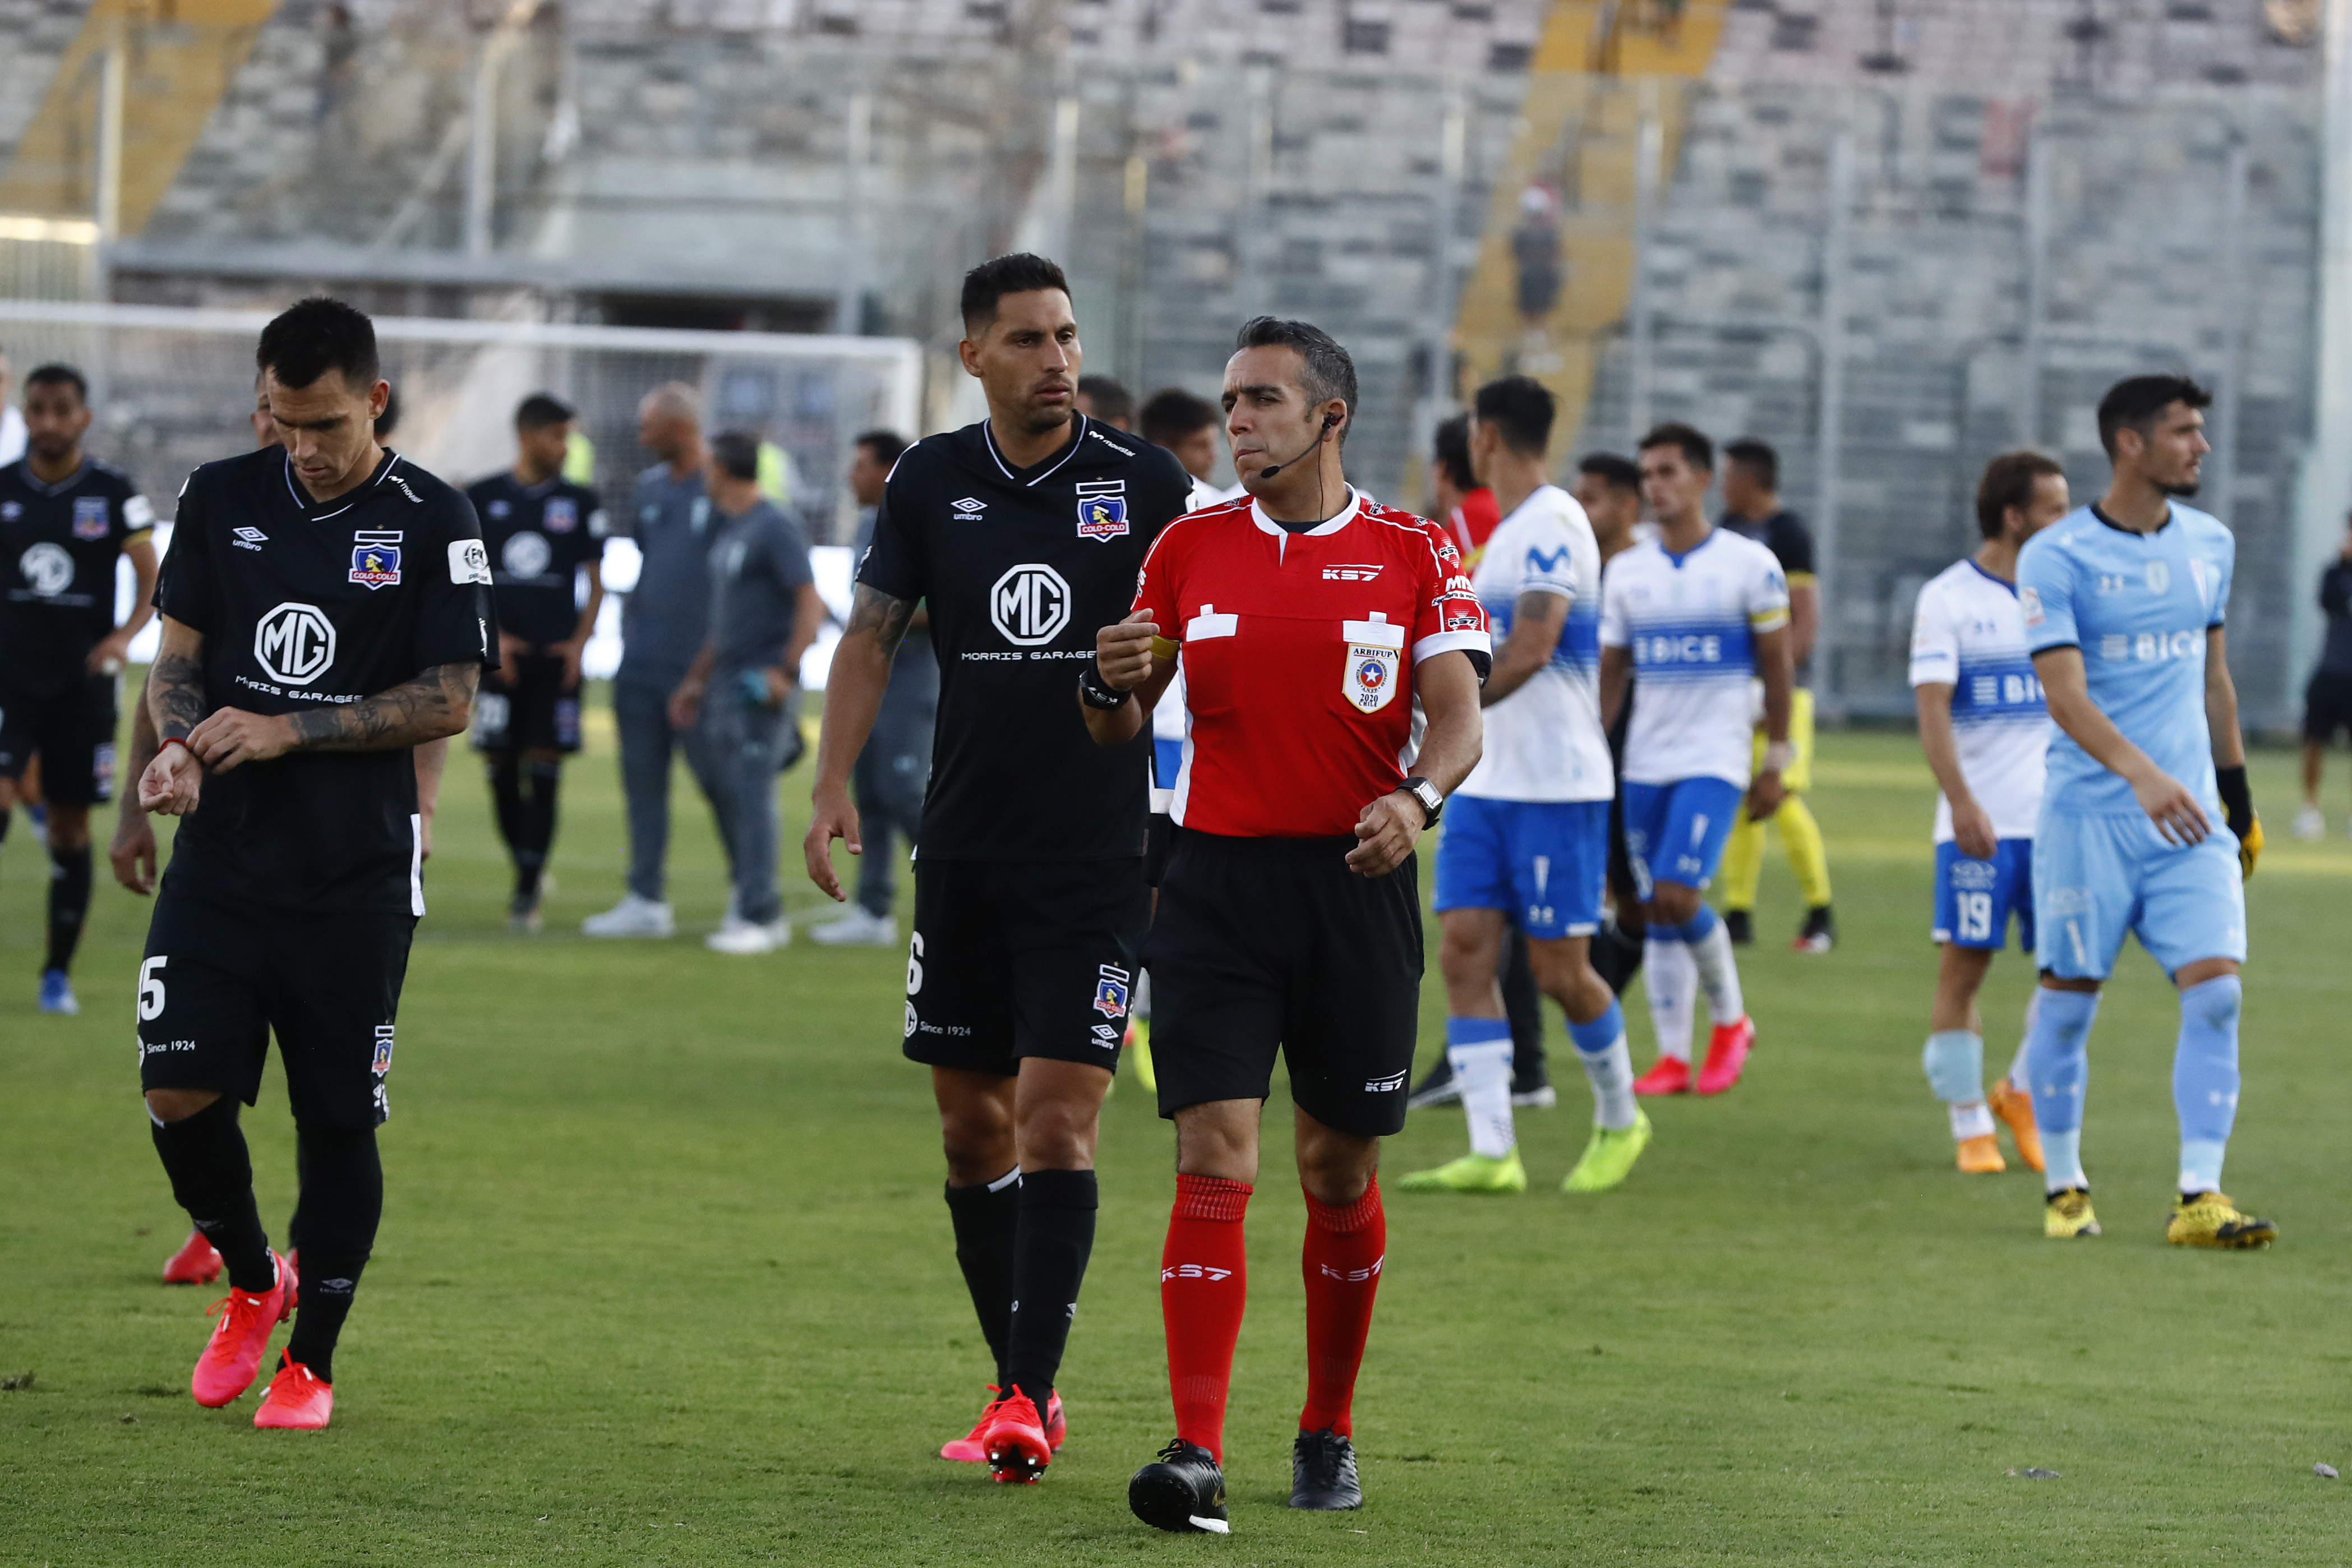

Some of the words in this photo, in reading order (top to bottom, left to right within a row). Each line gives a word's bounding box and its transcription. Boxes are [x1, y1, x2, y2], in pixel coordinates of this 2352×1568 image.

[953, 513, 983, 521] umbro
[1082, 524, 1126, 533] COLO-COLO
[232, 539, 262, 552] umbro
[353, 571, 396, 581] COLO-COLO
[1322, 569, 1380, 582] KS7
[1000, 573, 1061, 635] MG
[264, 612, 326, 675] MG
[962, 652, 1022, 661] MORRIS
[1030, 651, 1097, 660] GARAGE
[1353, 648, 1392, 658] ARBIFUP
[288, 690, 364, 704] GARAGES
[1361, 694, 1378, 702] 2020
[1957, 891, 1992, 941] 19
[137, 956, 168, 1025] 5
[920, 1021, 943, 1035] Since
[948, 1025, 971, 1036] 1924
[146, 1043, 167, 1054] Since
[170, 1040, 196, 1051] 1924
[1364, 1077, 1404, 1092] KS7
[1161, 1263, 1232, 1283] KS7
